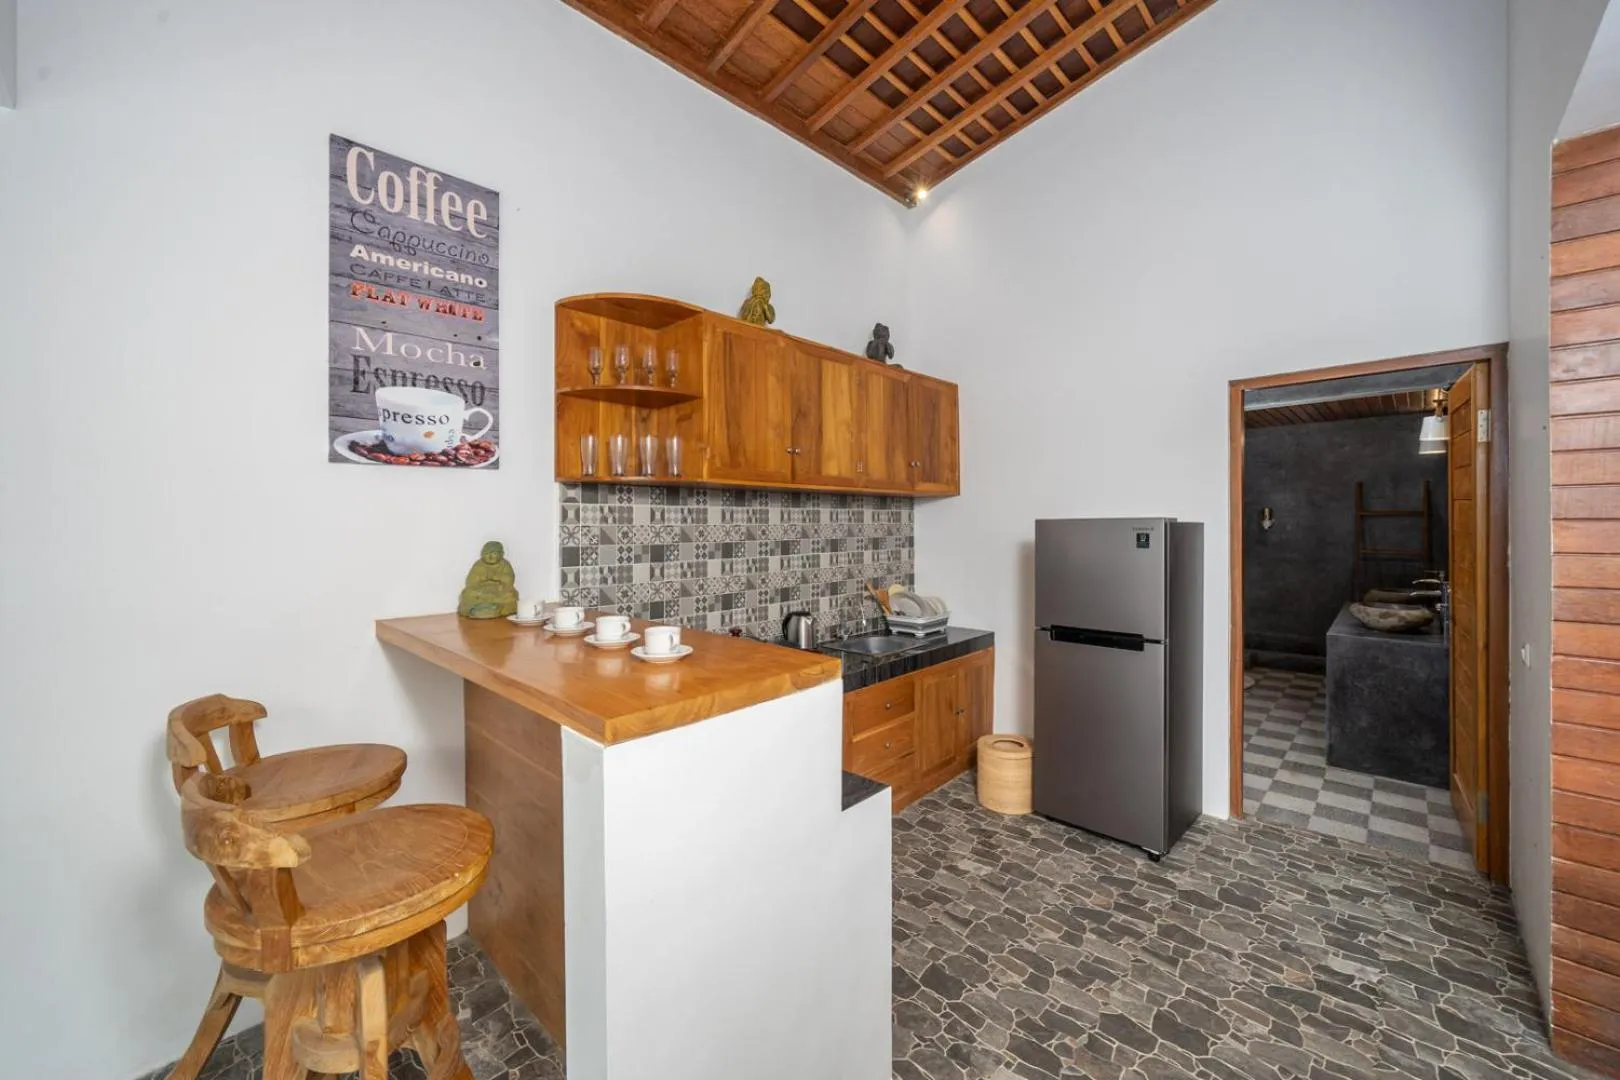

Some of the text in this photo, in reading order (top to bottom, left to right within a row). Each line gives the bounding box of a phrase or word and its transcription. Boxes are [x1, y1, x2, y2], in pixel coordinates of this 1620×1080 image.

[346, 146, 487, 239] Coffee
[350, 209, 490, 265] Cappuccino
[349, 263, 422, 289] CAFFE
[350, 244, 488, 289] Americano
[350, 280, 410, 307] FLAT
[351, 327, 488, 370] Mocha
[382, 408, 450, 425] presso
